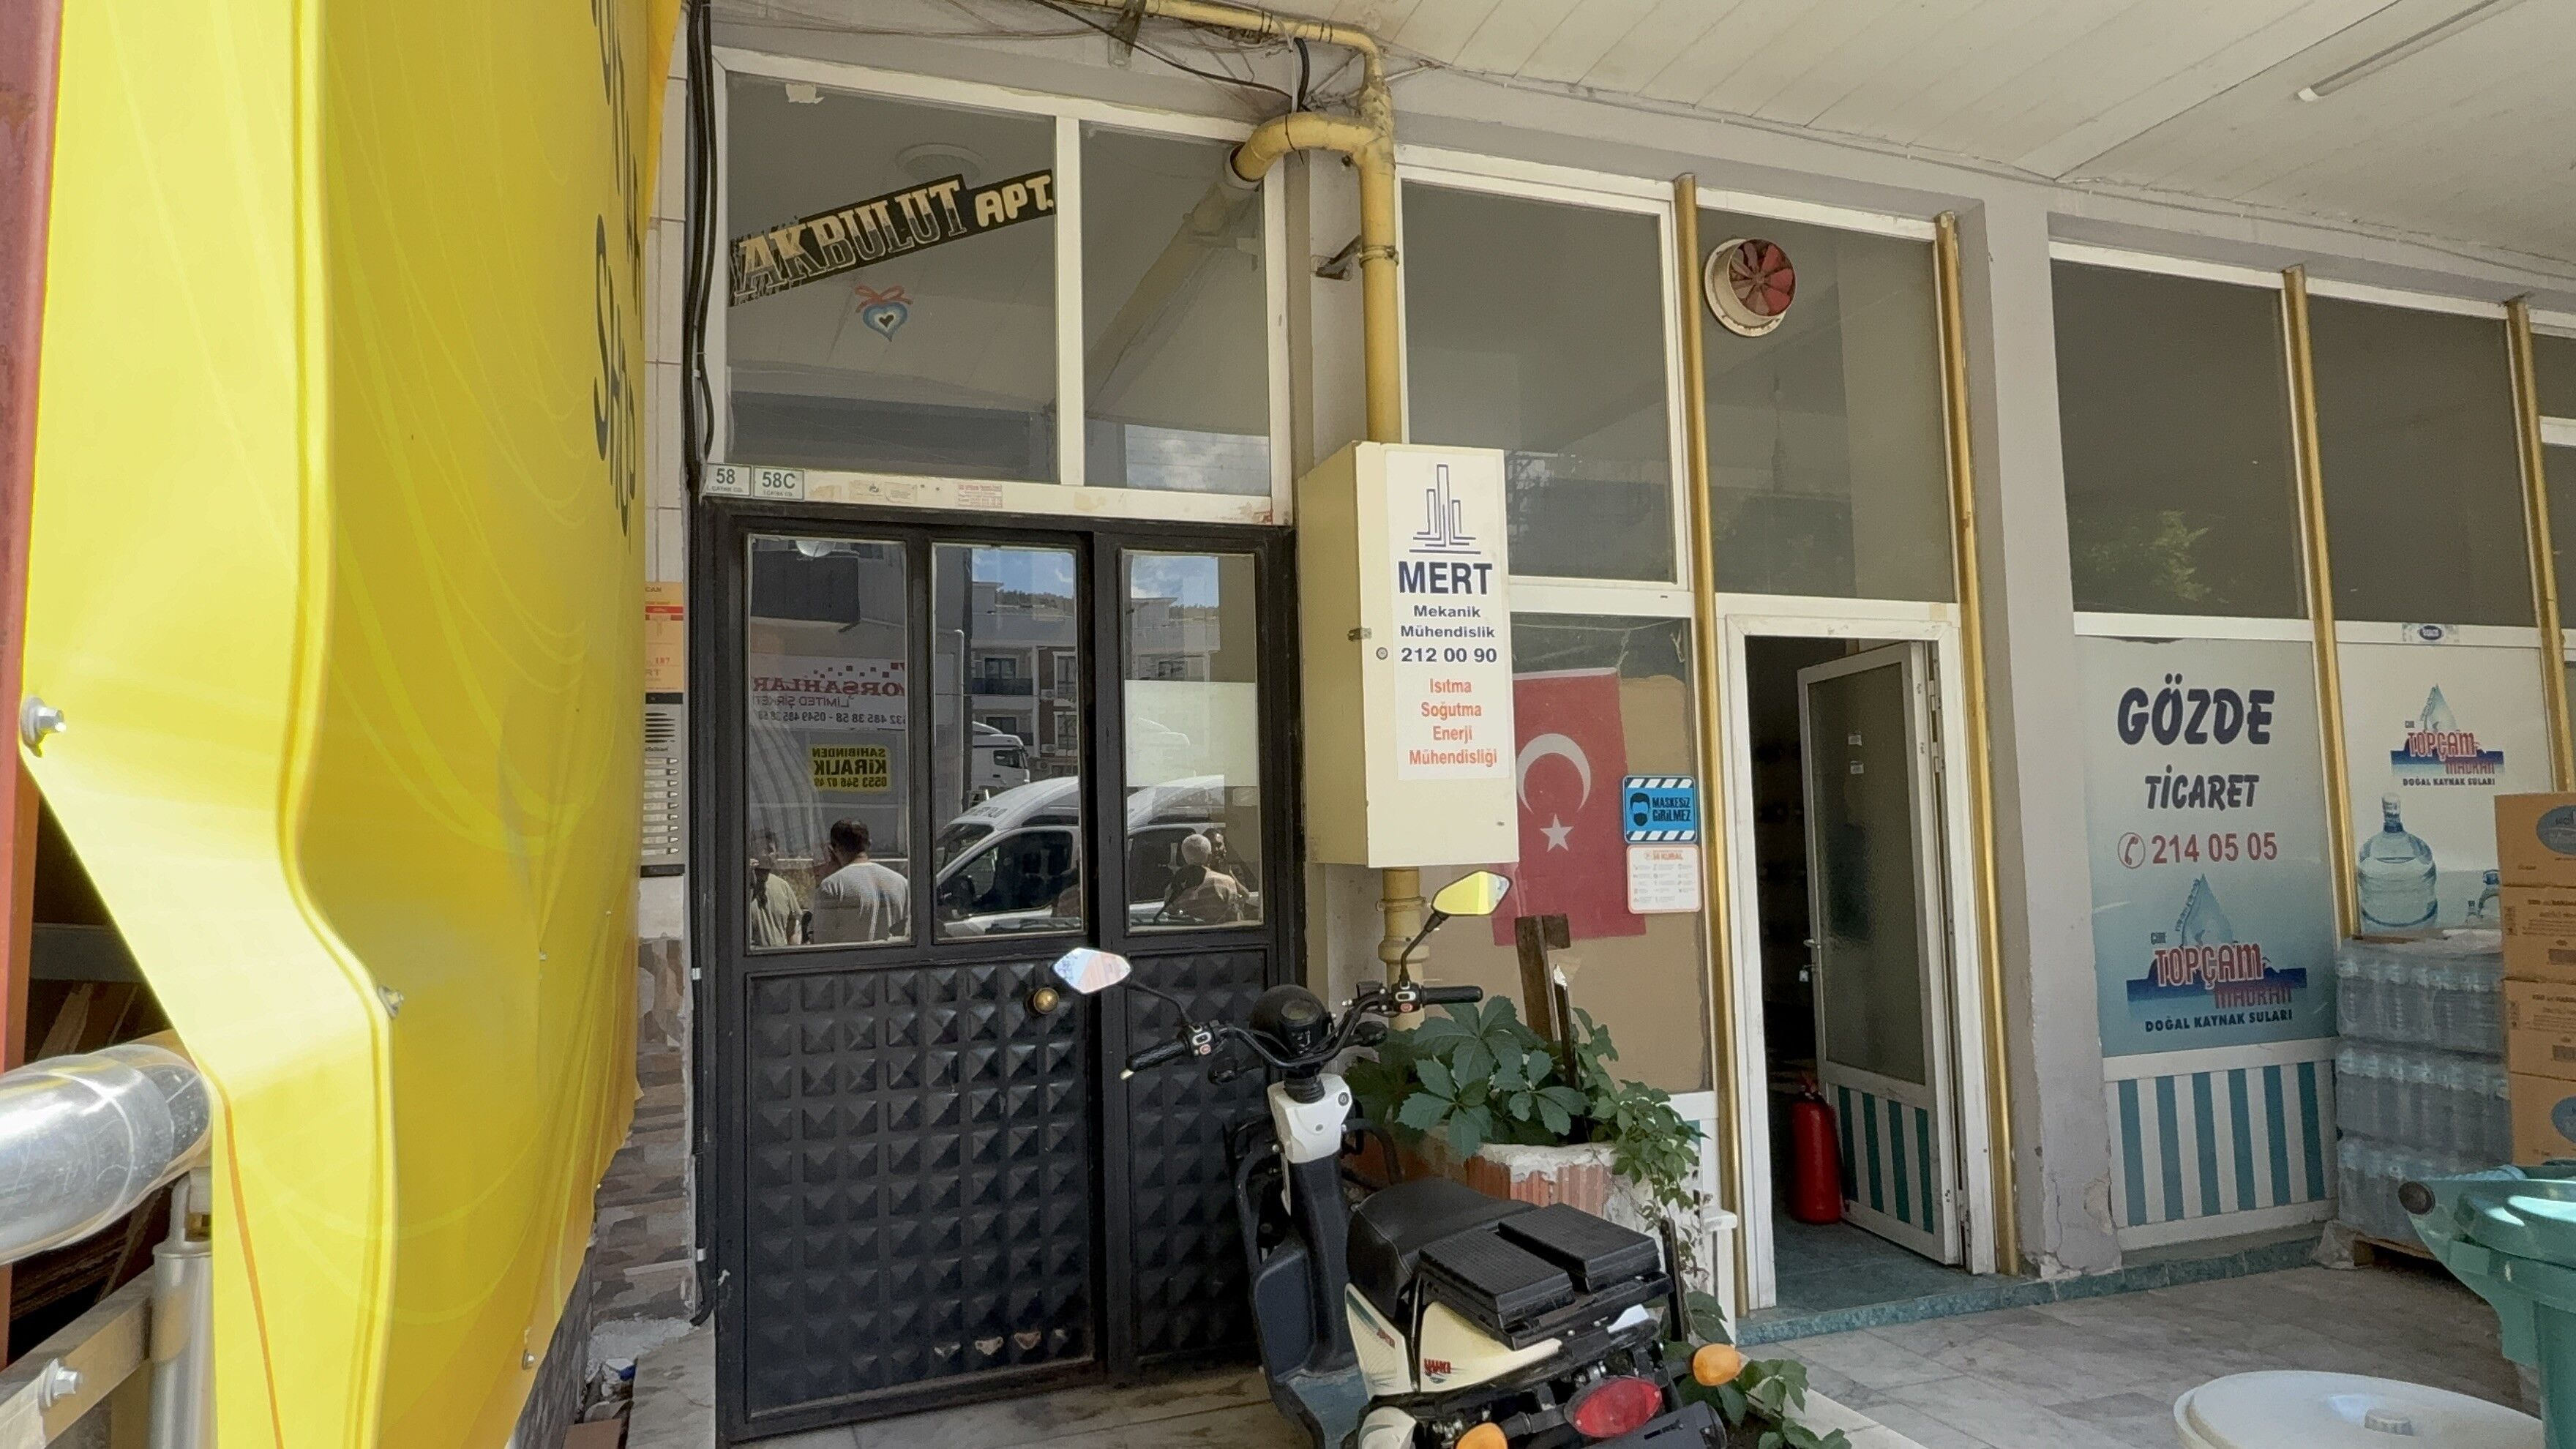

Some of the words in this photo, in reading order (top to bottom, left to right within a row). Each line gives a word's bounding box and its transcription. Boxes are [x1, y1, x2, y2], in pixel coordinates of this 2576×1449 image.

[734, 179, 967, 296] AKBULUT
[975, 175, 1054, 228] APT.
[594, 214, 636, 555] SHOP
[716, 468, 735, 484] 58
[762, 471, 795, 489] 58C
[1398, 561, 1493, 595] MERT
[1413, 604, 1481, 618] Mekanik
[1400, 625, 1495, 638] Mühendislik
[1401, 647, 1437, 662] 212
[1443, 648, 1467, 662] 00
[1474, 648, 1497, 663] 90
[1430, 678, 1472, 693] Isıtma
[1420, 701, 1482, 721] Soğutma
[2117, 673, 2274, 745] GÖZDE
[1433, 725, 1472, 744] Enerji
[1409, 748, 1497, 768] Mühendisliği
[2145, 764, 2259, 811] TİCARET
[2152, 834, 2200, 864] 214
[2209, 833, 2239, 862] 05
[2247, 832, 2277, 861] 05
[2154, 943, 2263, 989] TOPÇAM
[2145, 1016, 2190, 1033] DOĞAL
[2195, 1013, 2245, 1028] KAYNAK
[2249, 1009, 2293, 1025] SULARI
